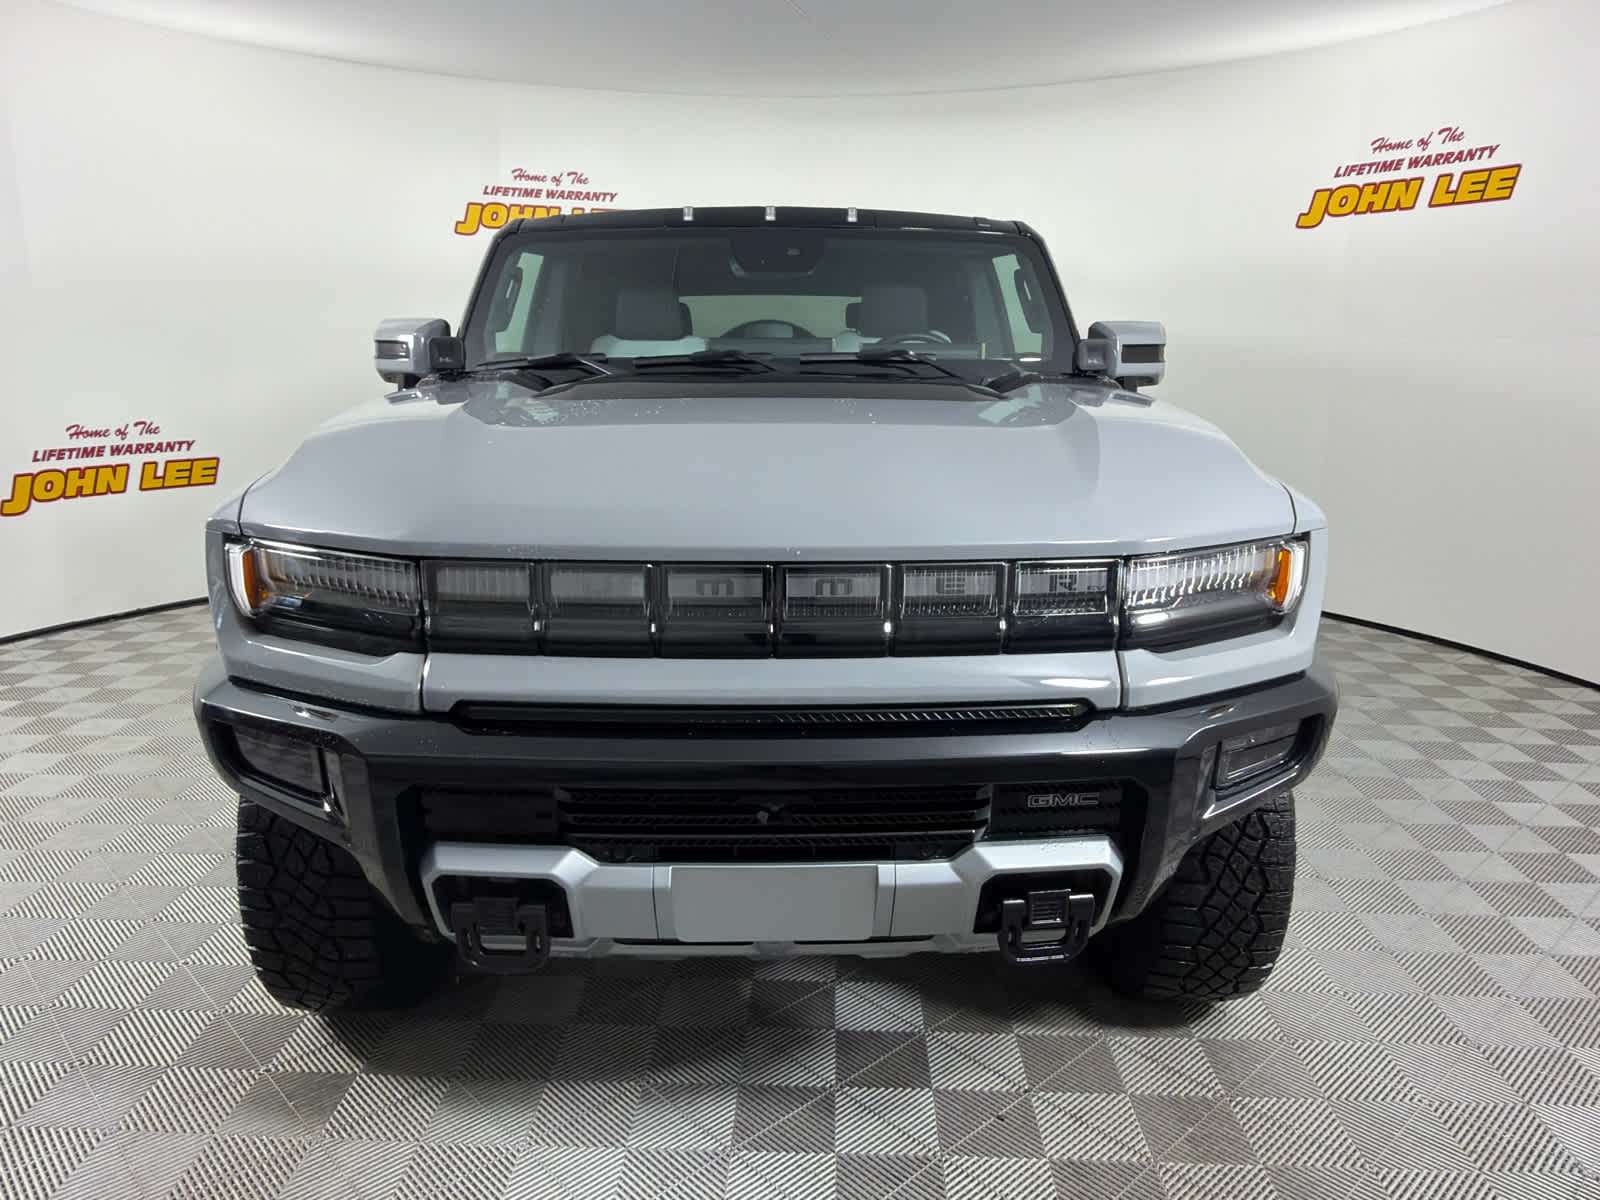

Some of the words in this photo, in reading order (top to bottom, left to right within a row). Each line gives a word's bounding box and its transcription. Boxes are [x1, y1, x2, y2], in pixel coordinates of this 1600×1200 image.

[1370, 136, 1414, 154] Home
[1416, 131, 1433, 150] of
[1437, 126, 1465, 144] The
[1334, 159, 1403, 178] LIFETIME
[1407, 144, 1500, 169] WARRANTY
[511, 168, 548, 183] Home
[550, 172, 564, 187] of
[567, 171, 589, 185] The
[482, 185, 543, 199] LIFETIME
[545, 188, 618, 203] WARRANTY
[1296, 176, 1425, 229] JOHN
[1427, 163, 1522, 209] LEE
[65, 424, 110, 440] Home
[114, 424, 129, 441] of
[133, 420, 160, 436] The
[32, 446, 105, 462] LIFETIME
[110, 440, 196, 456] WARRANTY
[0, 464, 130, 517] JOHN
[139, 457, 219, 491] LEE
[1027, 792, 1100, 808] GMC
